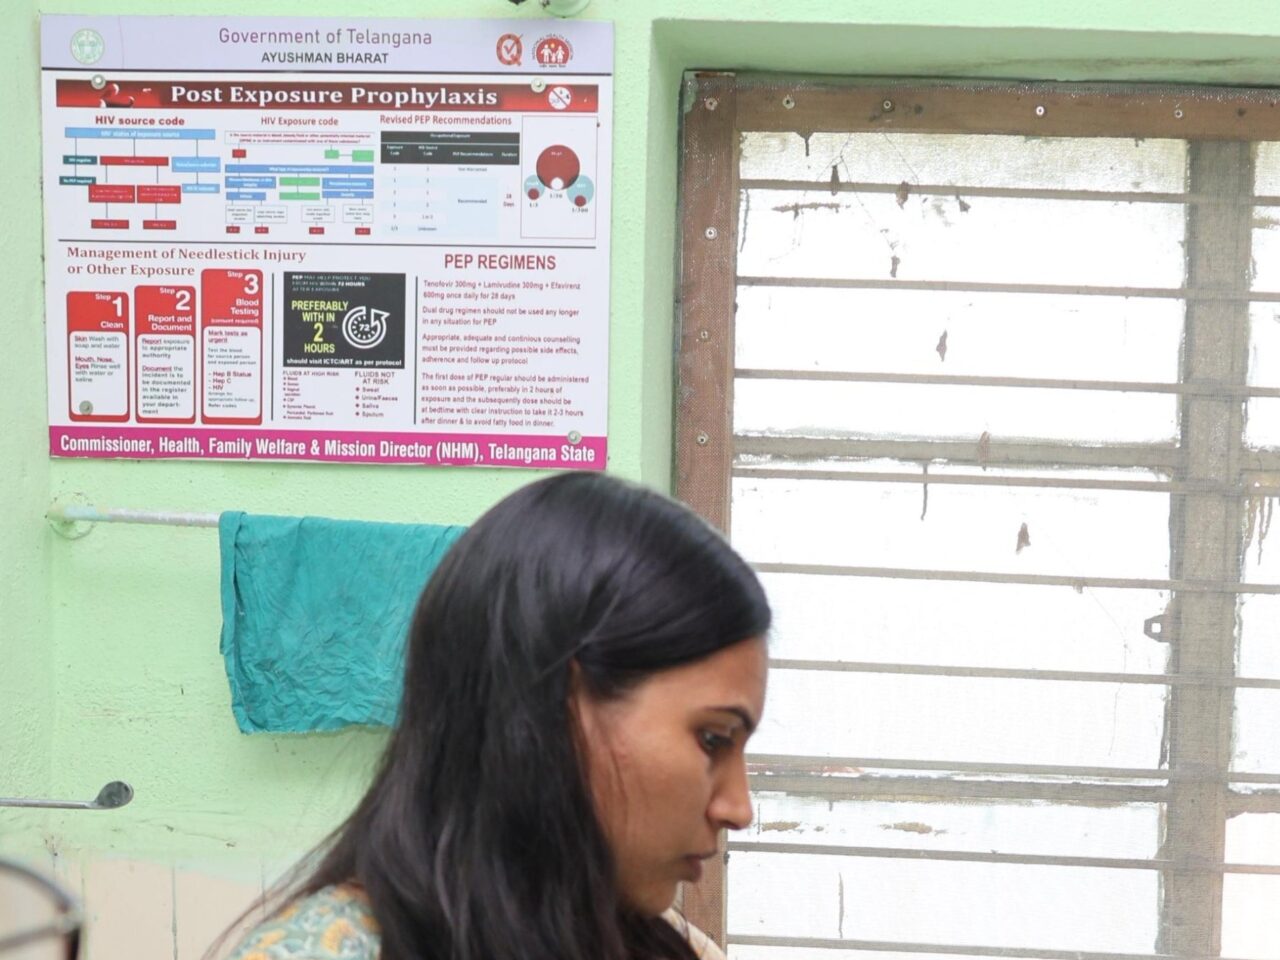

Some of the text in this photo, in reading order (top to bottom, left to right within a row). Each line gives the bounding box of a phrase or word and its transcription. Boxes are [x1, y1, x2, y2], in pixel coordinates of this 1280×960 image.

[219, 28, 432, 48] Government of Telangana
[261, 52, 388, 64] AYUSHMAN BHARAT
[171, 86, 497, 108] Post Exposure Prophylaxis
[95, 115, 185, 126] HIV source code
[260, 116, 339, 127] HIV Exposure code
[380, 115, 512, 126] Revised PEP Recommendations
[67, 247, 306, 263] Management of Needlestick Injury
[444, 254, 557, 270] PEP REGIMENS
[67, 264, 196, 278] or Other Exposure
[227, 270, 243, 279] Step
[244, 273, 259, 295] 3
[159, 287, 175, 296] Step
[463, 292, 478, 301] daily
[500, 292, 516, 301] days
[95, 293, 111, 302] Step
[175, 290, 191, 311] 2
[235, 298, 259, 307] Blood
[112, 296, 123, 317] 1
[291, 300, 349, 311] PREFERABLY
[230, 307, 259, 317] Testing
[302, 312, 335, 322] WITH IN
[422, 306, 437, 314] Dual
[438, 306, 453, 316] drug
[455, 307, 481, 316] regimen
[482, 307, 505, 315] should
[545, 310, 557, 318] any
[558, 308, 579, 317] longer
[100, 320, 124, 329] Clean
[148, 314, 192, 324] Report and
[483, 318, 497, 326] PEP
[151, 322, 192, 332] Document
[313, 322, 324, 342] 2
[359, 323, 370, 331] 72
[304, 343, 335, 354] HOURS
[375, 359, 402, 367] protocol
[60, 435, 595, 465] Commissioner, Health, Family Welfare & Mission Director (NHM), Telangana State
